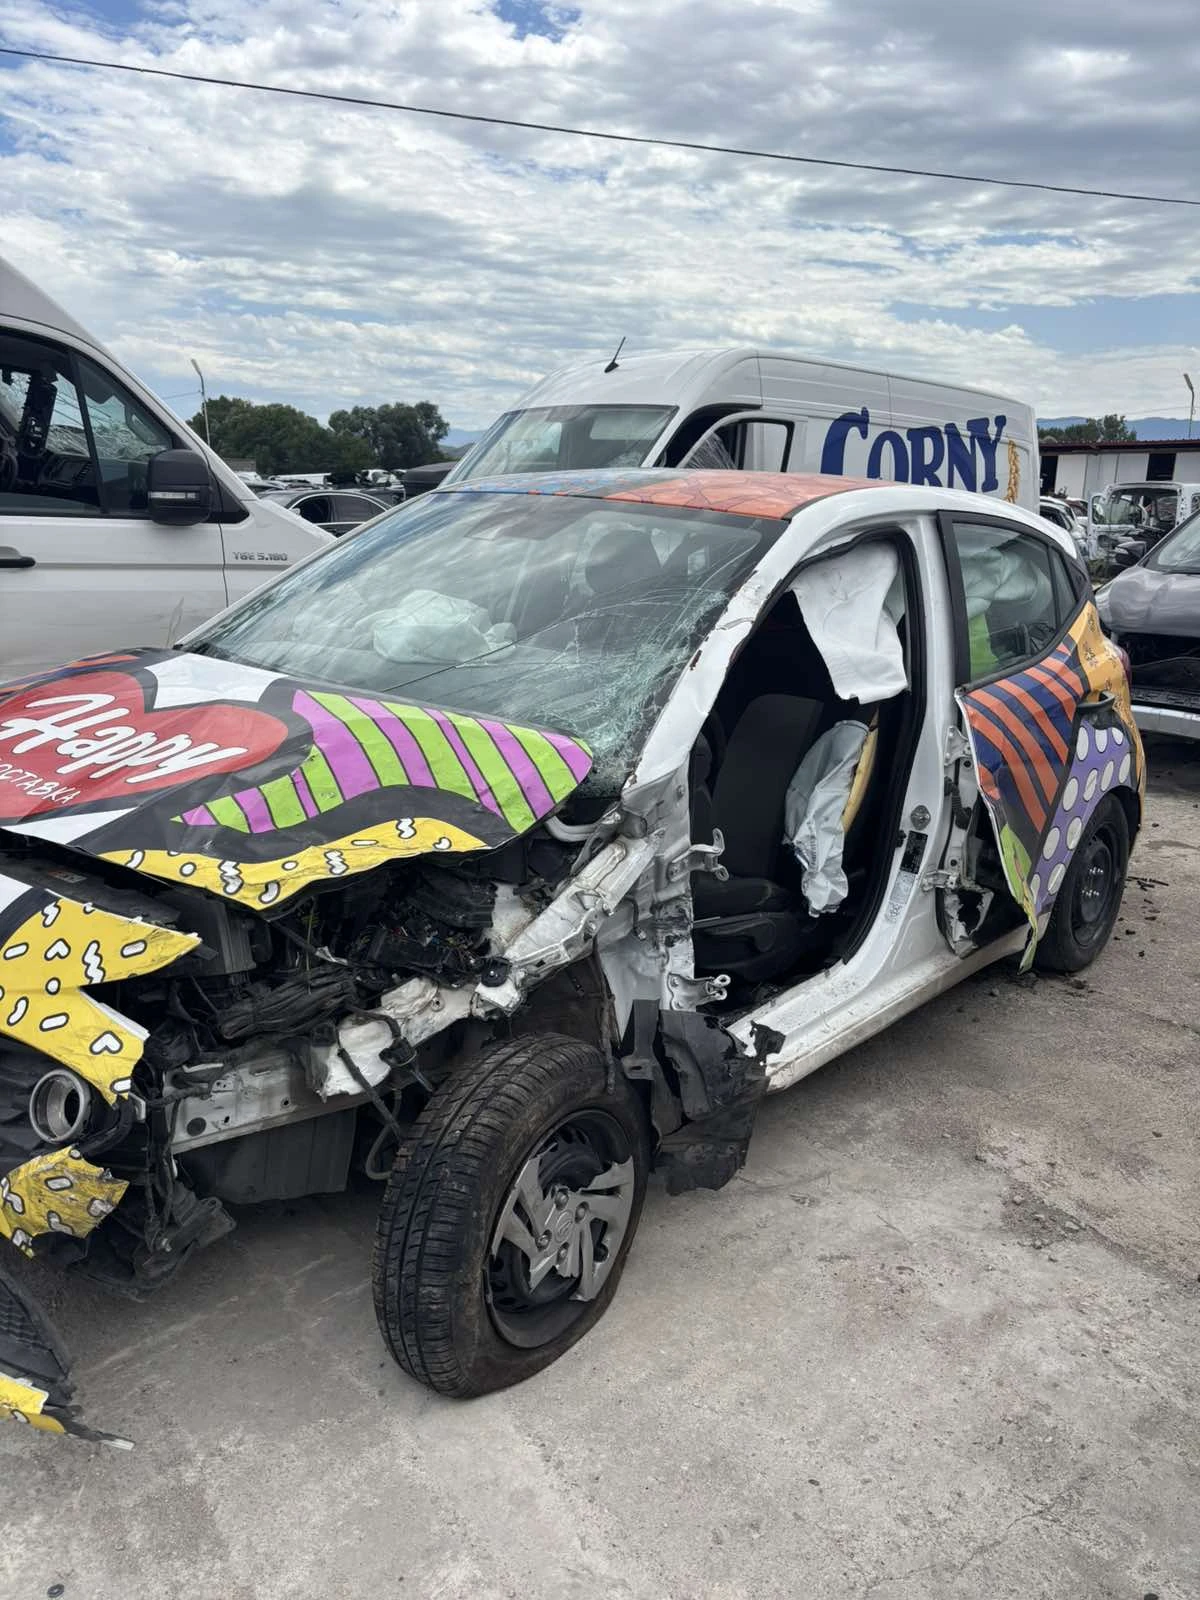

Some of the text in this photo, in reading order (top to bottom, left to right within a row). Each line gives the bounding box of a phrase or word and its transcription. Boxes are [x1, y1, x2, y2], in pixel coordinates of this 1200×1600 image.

[820, 407, 1007, 493] CORNY
[0, 693, 249, 784] Happy
[0, 758, 81, 804] ОСТАВКА
